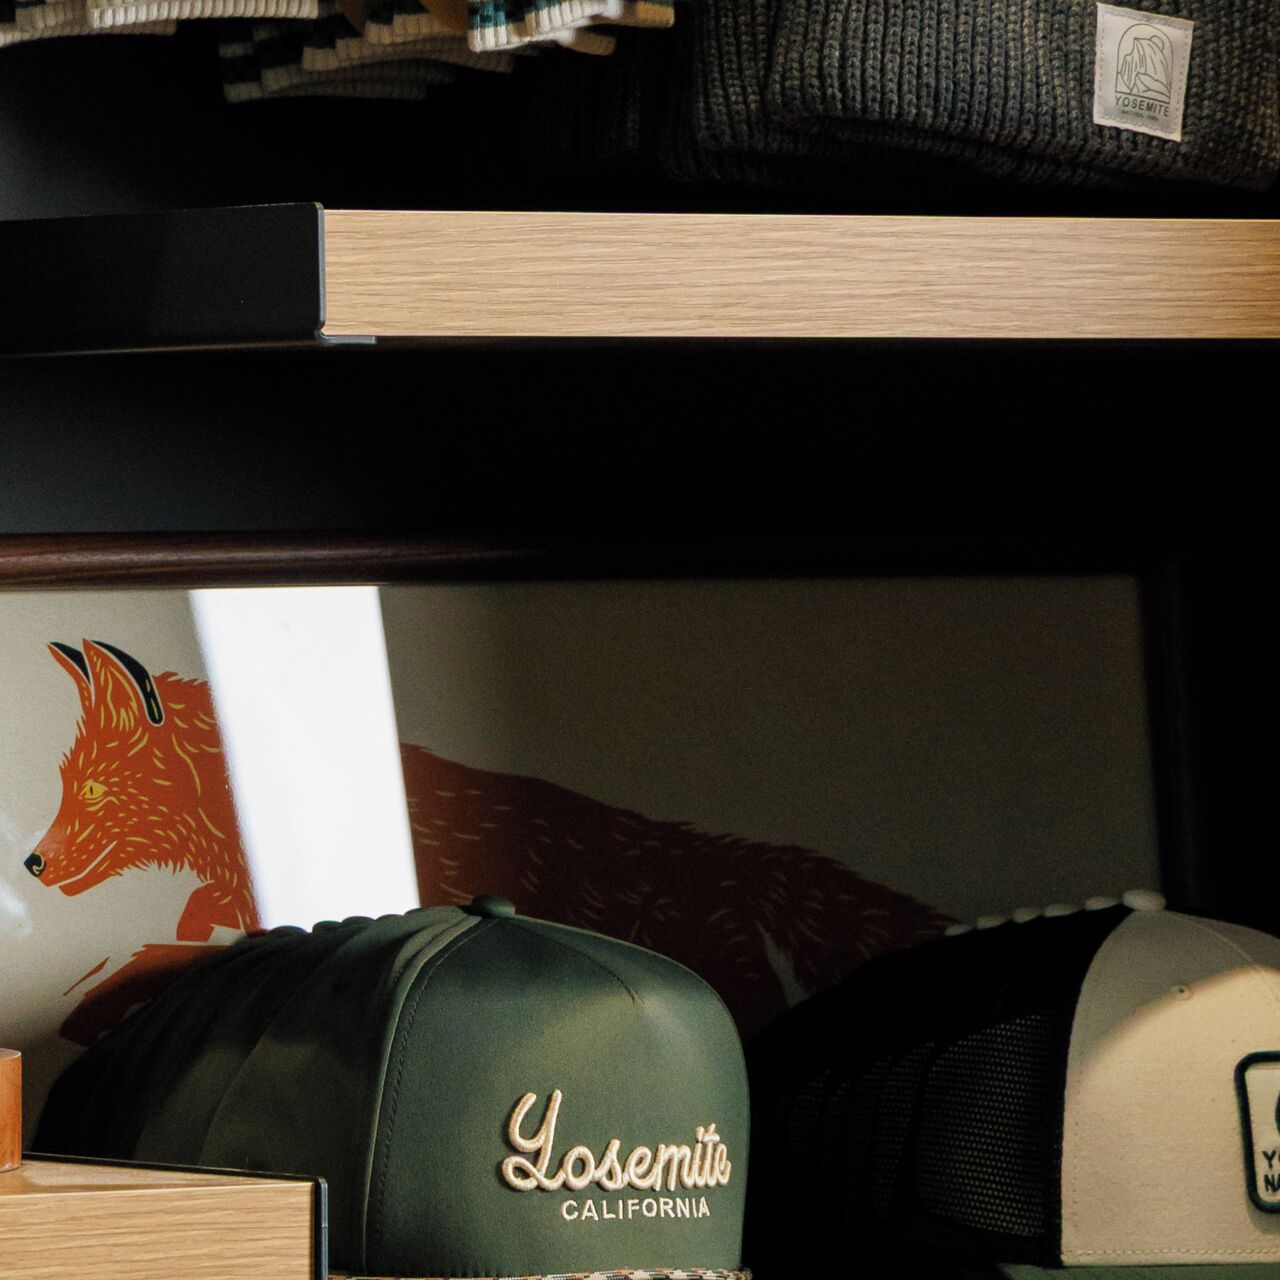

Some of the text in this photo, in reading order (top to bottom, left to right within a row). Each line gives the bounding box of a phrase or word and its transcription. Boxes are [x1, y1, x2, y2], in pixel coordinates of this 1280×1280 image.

[1114, 94, 1171, 117] YOSEMITE
[501, 1088, 733, 1193] Yosemite
[560, 1195, 712, 1222] CALIFORNIA
